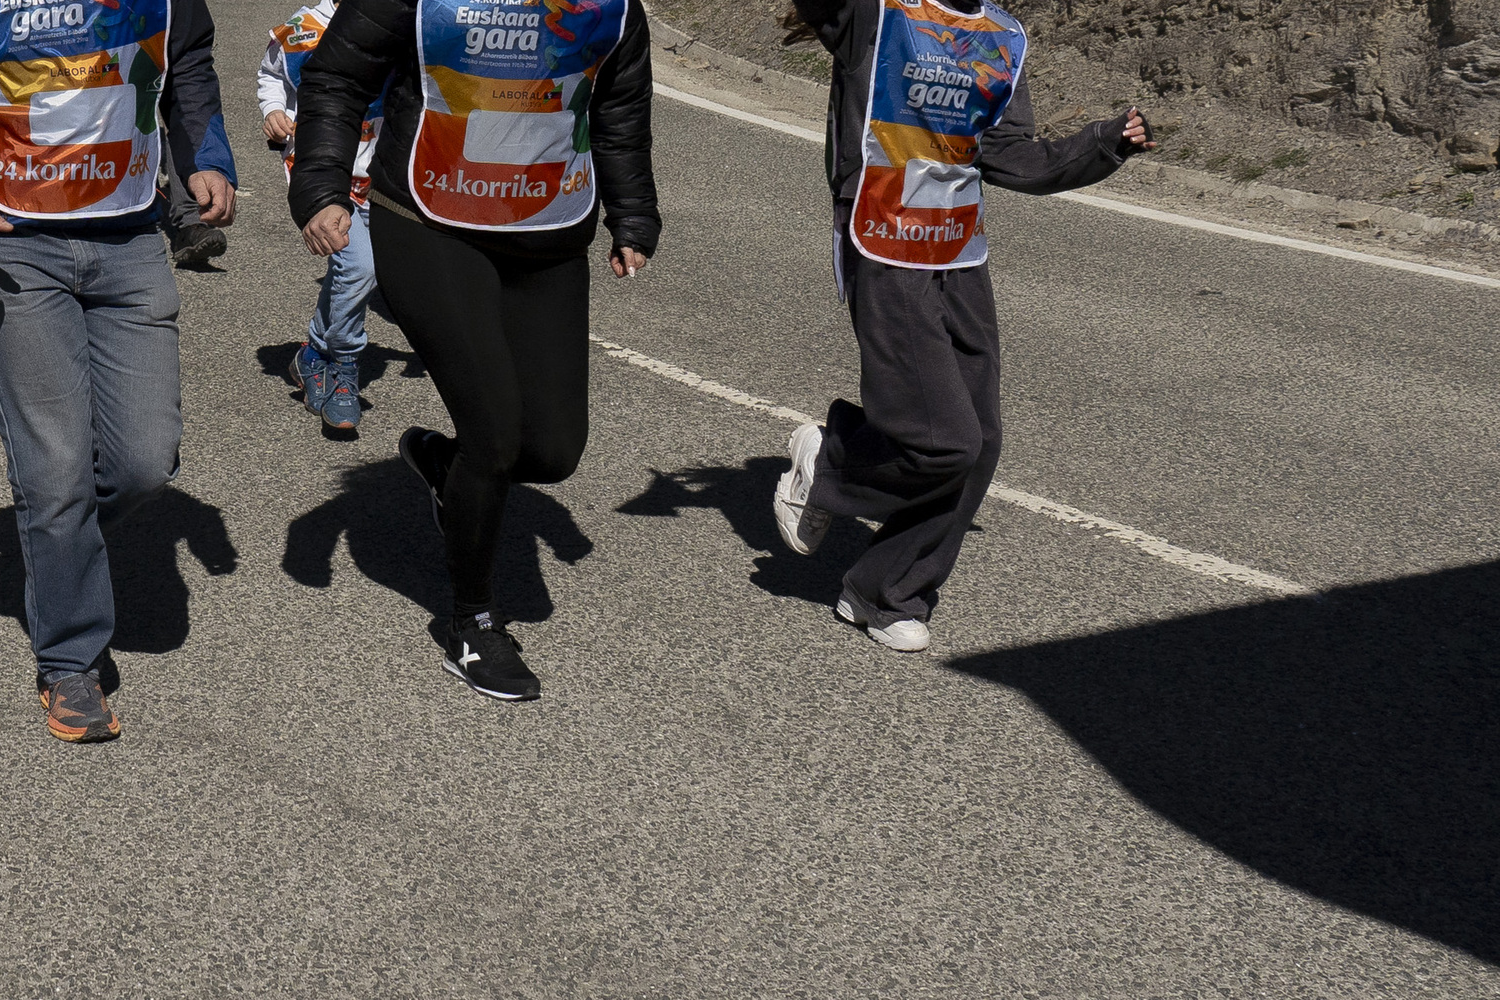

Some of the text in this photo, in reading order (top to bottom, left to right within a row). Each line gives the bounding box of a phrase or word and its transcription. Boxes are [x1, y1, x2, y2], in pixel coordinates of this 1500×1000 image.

[11, 3, 84, 41] gara
[456, 6, 539, 27] Euskara
[464, 27, 539, 54] gara
[50, 65, 101, 78] LABORAL
[916, 52, 957, 66] 24.korrika
[902, 62, 973, 88] Euskara
[492, 90, 542, 100] LABORAL
[907, 83, 970, 109] gara
[423, 160, 591, 198] 24.korrika aek
[862, 216, 964, 242] 24.korrika
